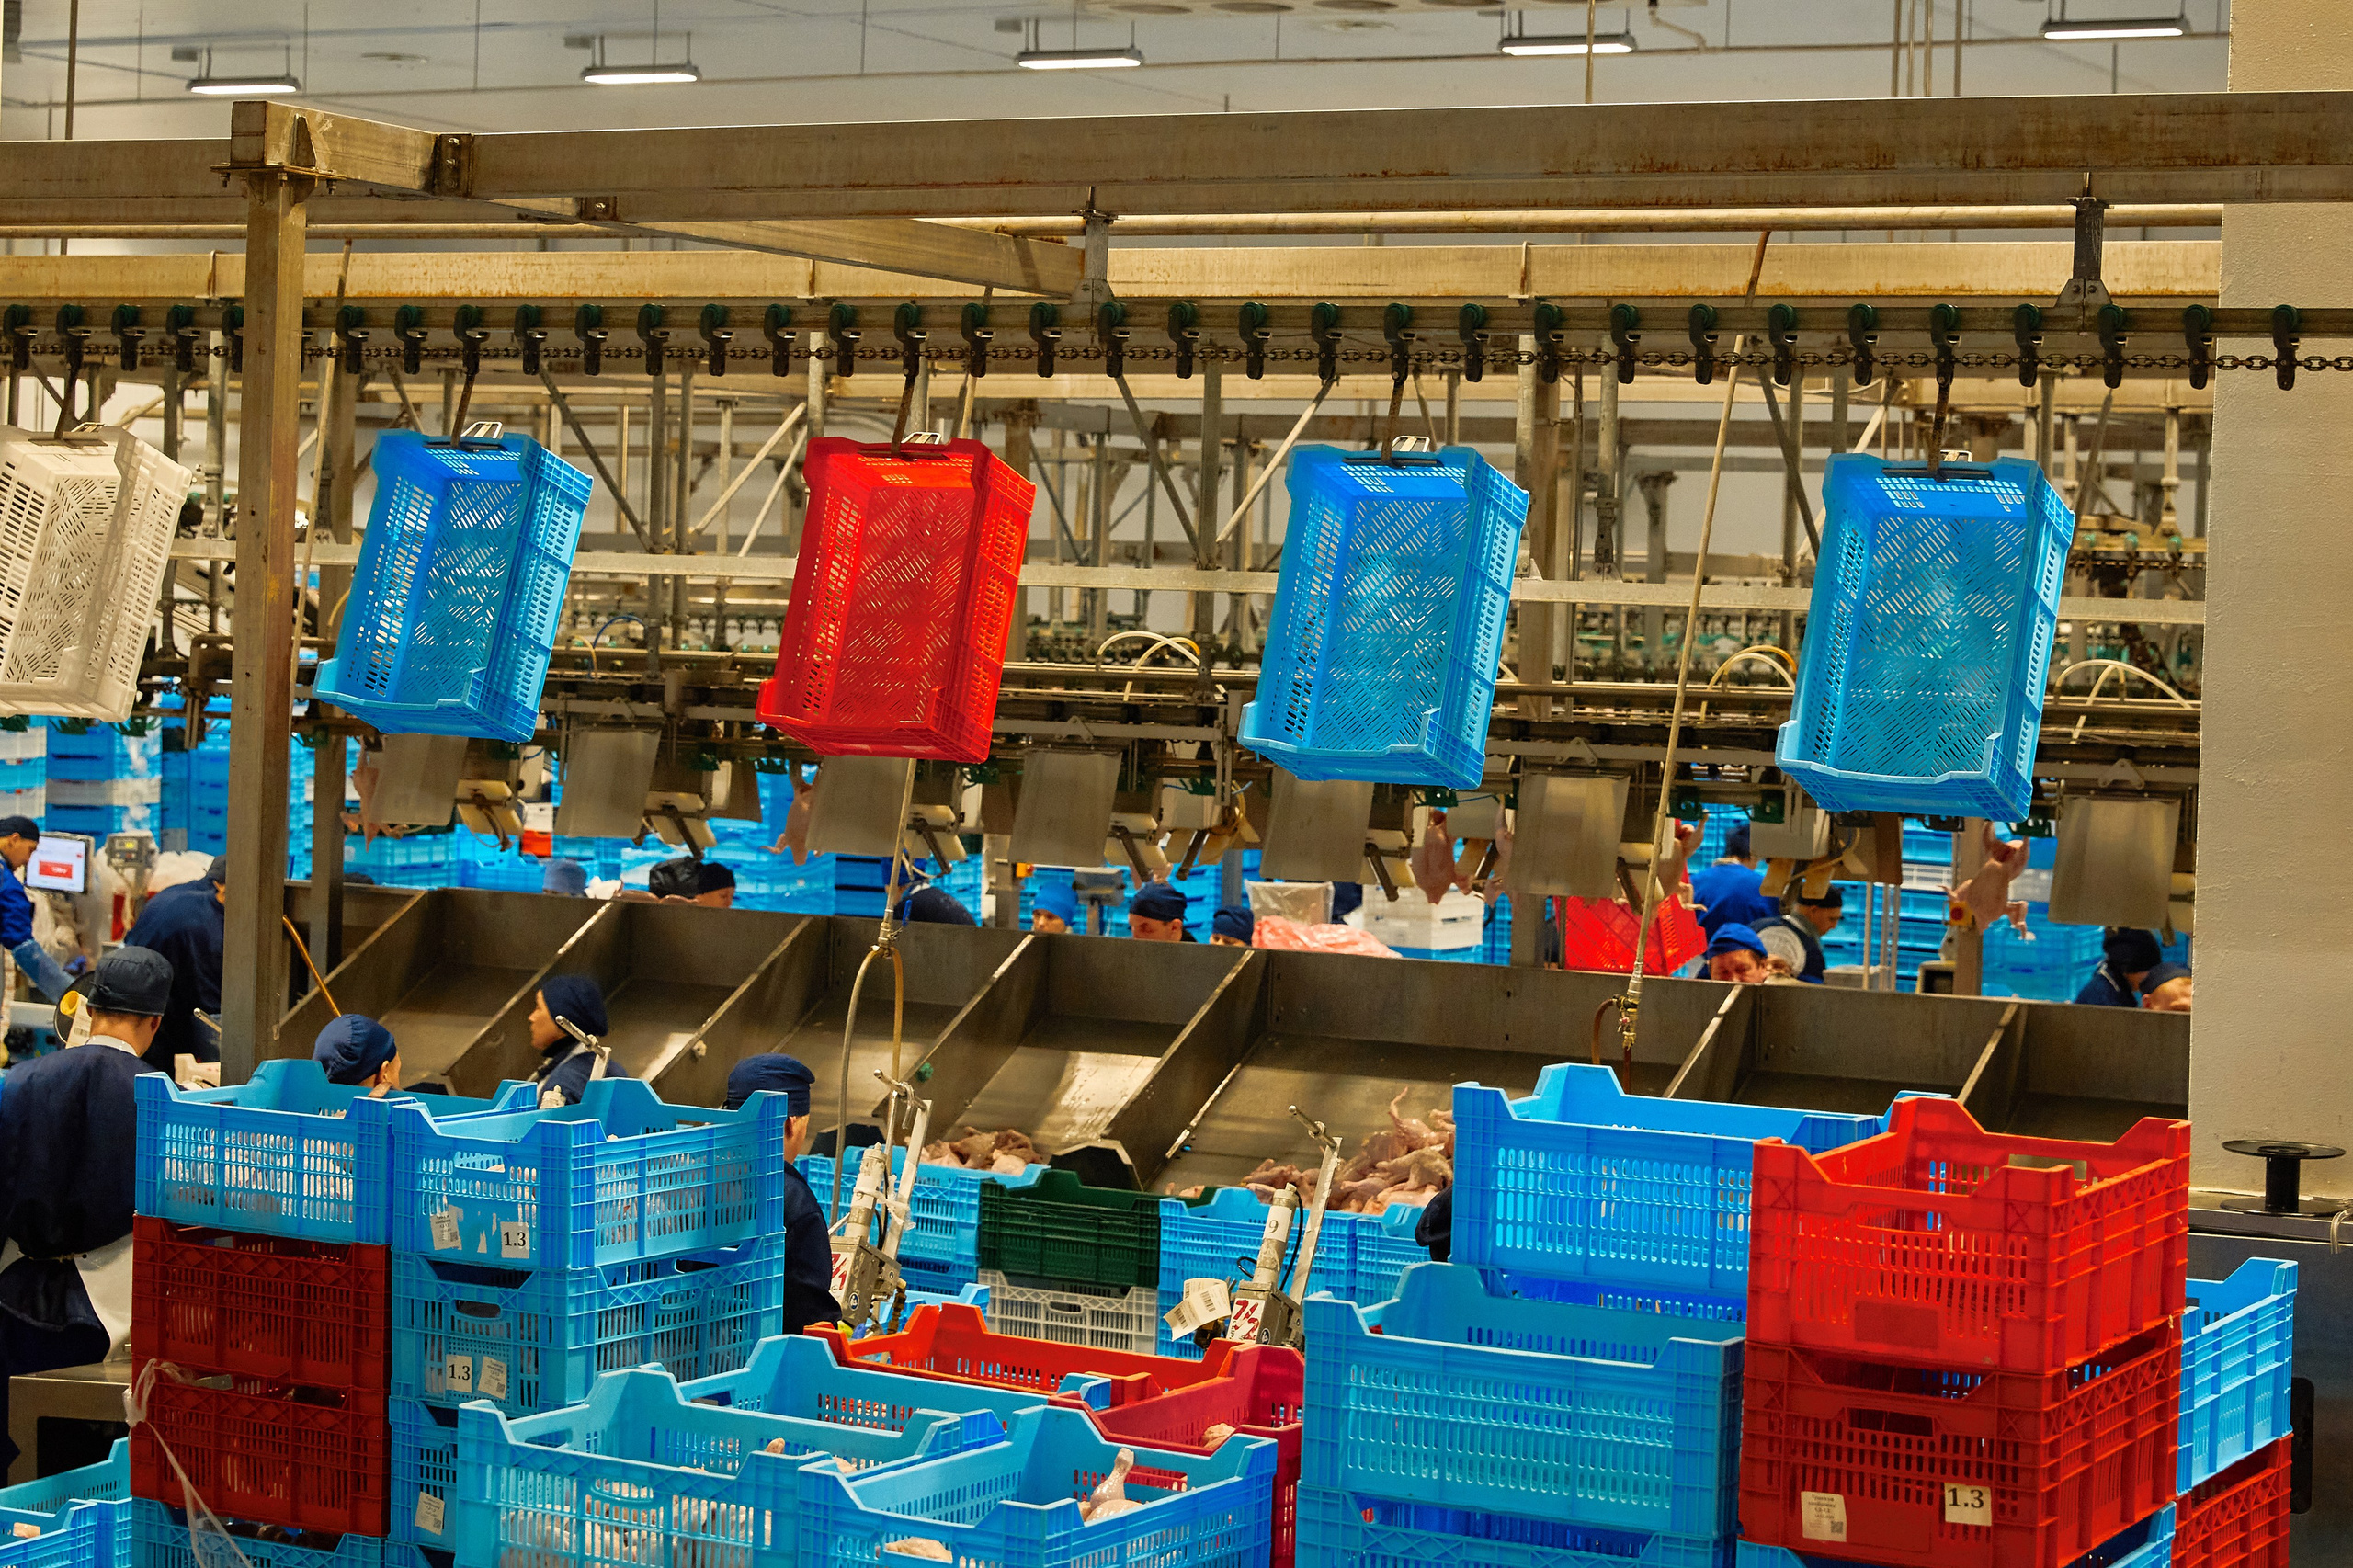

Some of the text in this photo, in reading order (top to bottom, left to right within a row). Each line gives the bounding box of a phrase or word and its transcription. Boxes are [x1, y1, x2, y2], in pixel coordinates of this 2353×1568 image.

[1268, 1219, 1279, 1233] 9
[503, 1231, 527, 1247] 1.3
[448, 1363, 471, 1381] 1.3
[1947, 1487, 1984, 1509] 1.3
